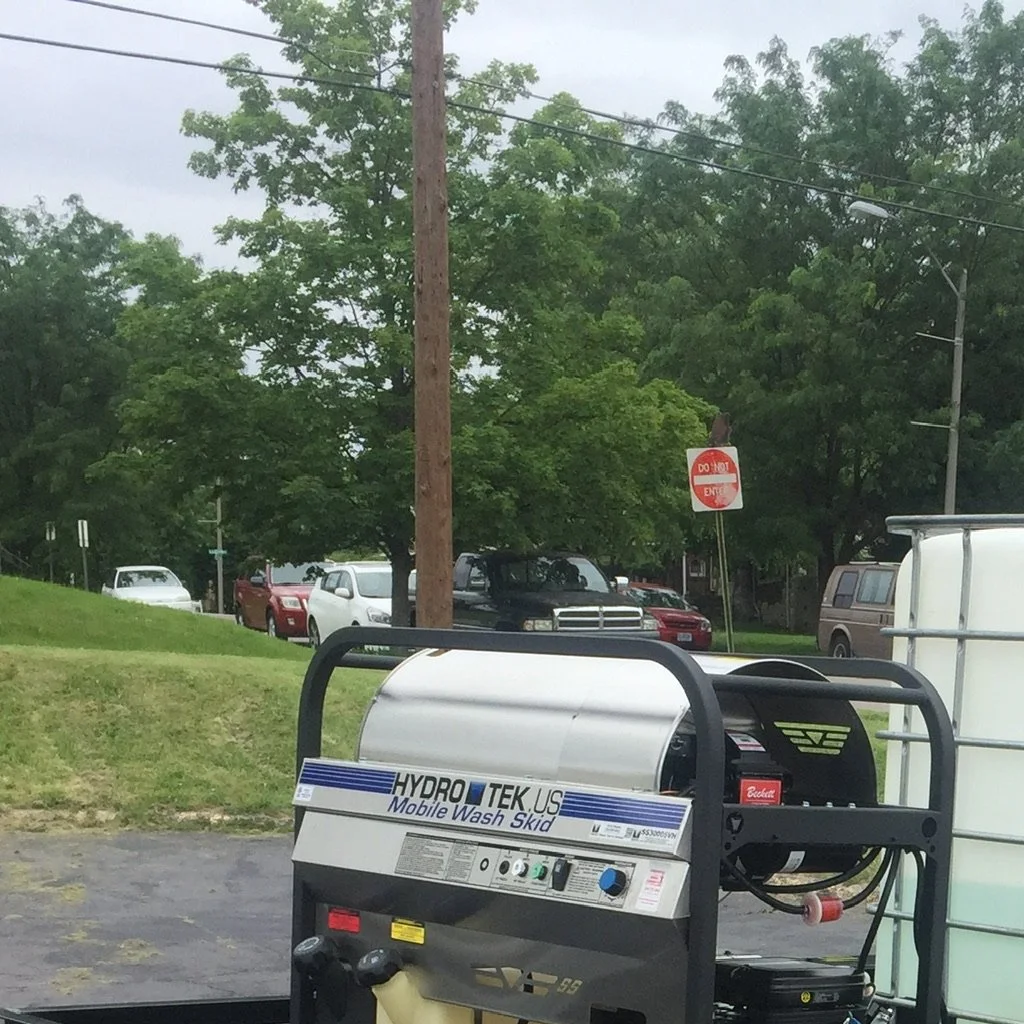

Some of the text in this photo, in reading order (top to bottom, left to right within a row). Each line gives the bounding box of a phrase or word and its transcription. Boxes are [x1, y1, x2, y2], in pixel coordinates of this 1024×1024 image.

[698, 461, 730, 473] DO NOT
[391, 772, 467, 804] HYDRO
[746, 785, 776, 799] Beckett
[387, 795, 556, 833] Mobile Wash Skid
